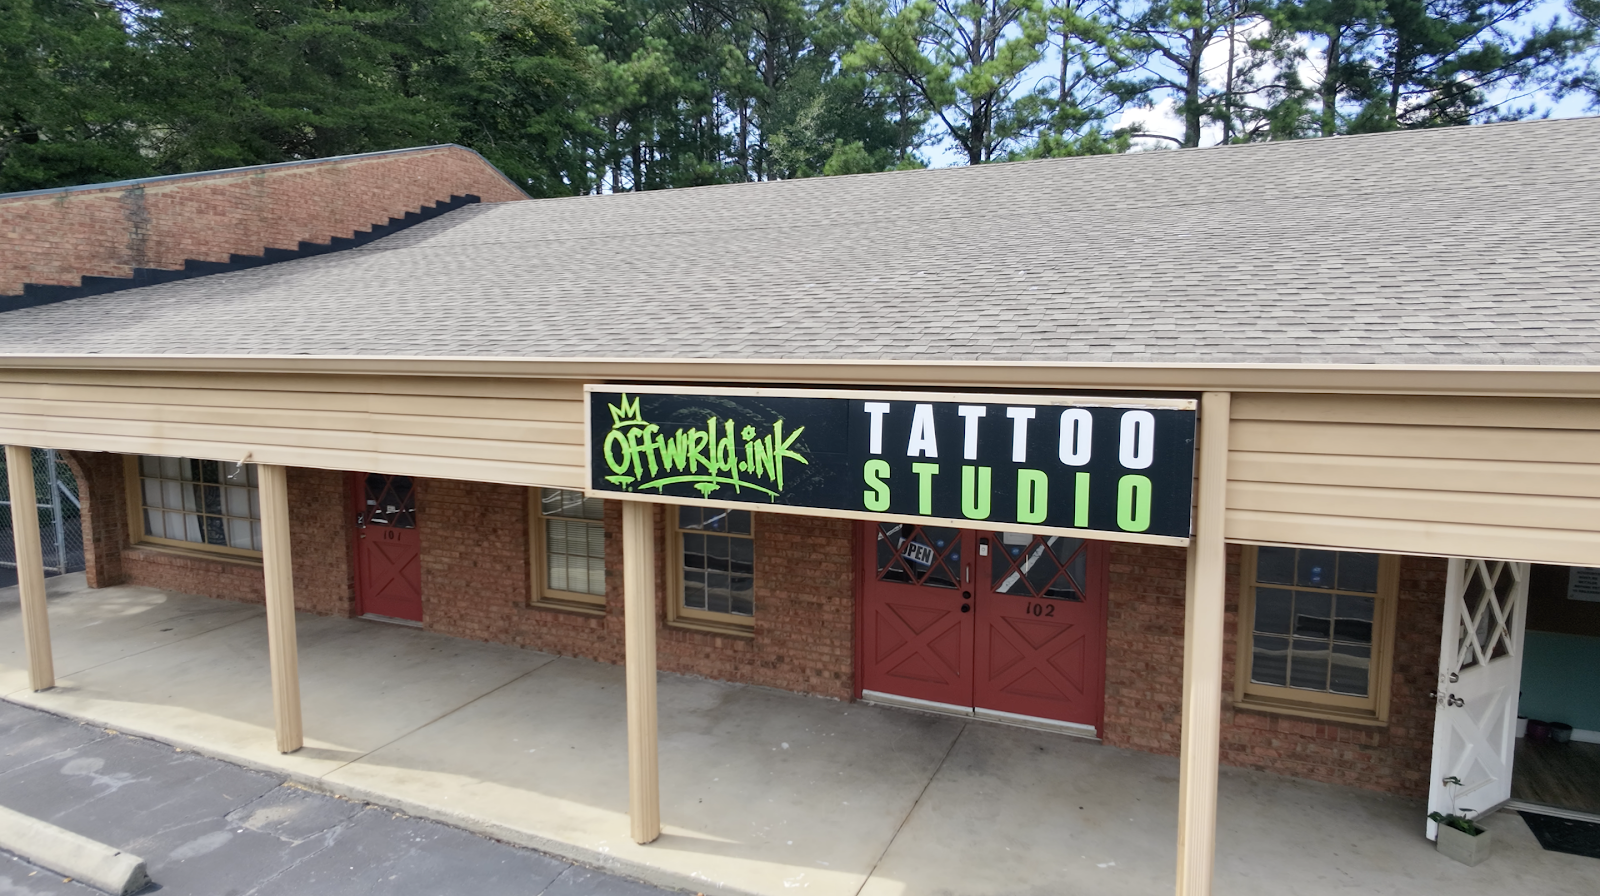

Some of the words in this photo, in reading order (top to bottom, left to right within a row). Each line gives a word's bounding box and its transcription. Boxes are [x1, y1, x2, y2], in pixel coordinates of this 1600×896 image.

[863, 401, 1156, 470] TATTOO
[864, 459, 1153, 533] STUDIO
[384, 531, 401, 541] 101
[1026, 602, 1055, 617] 102
